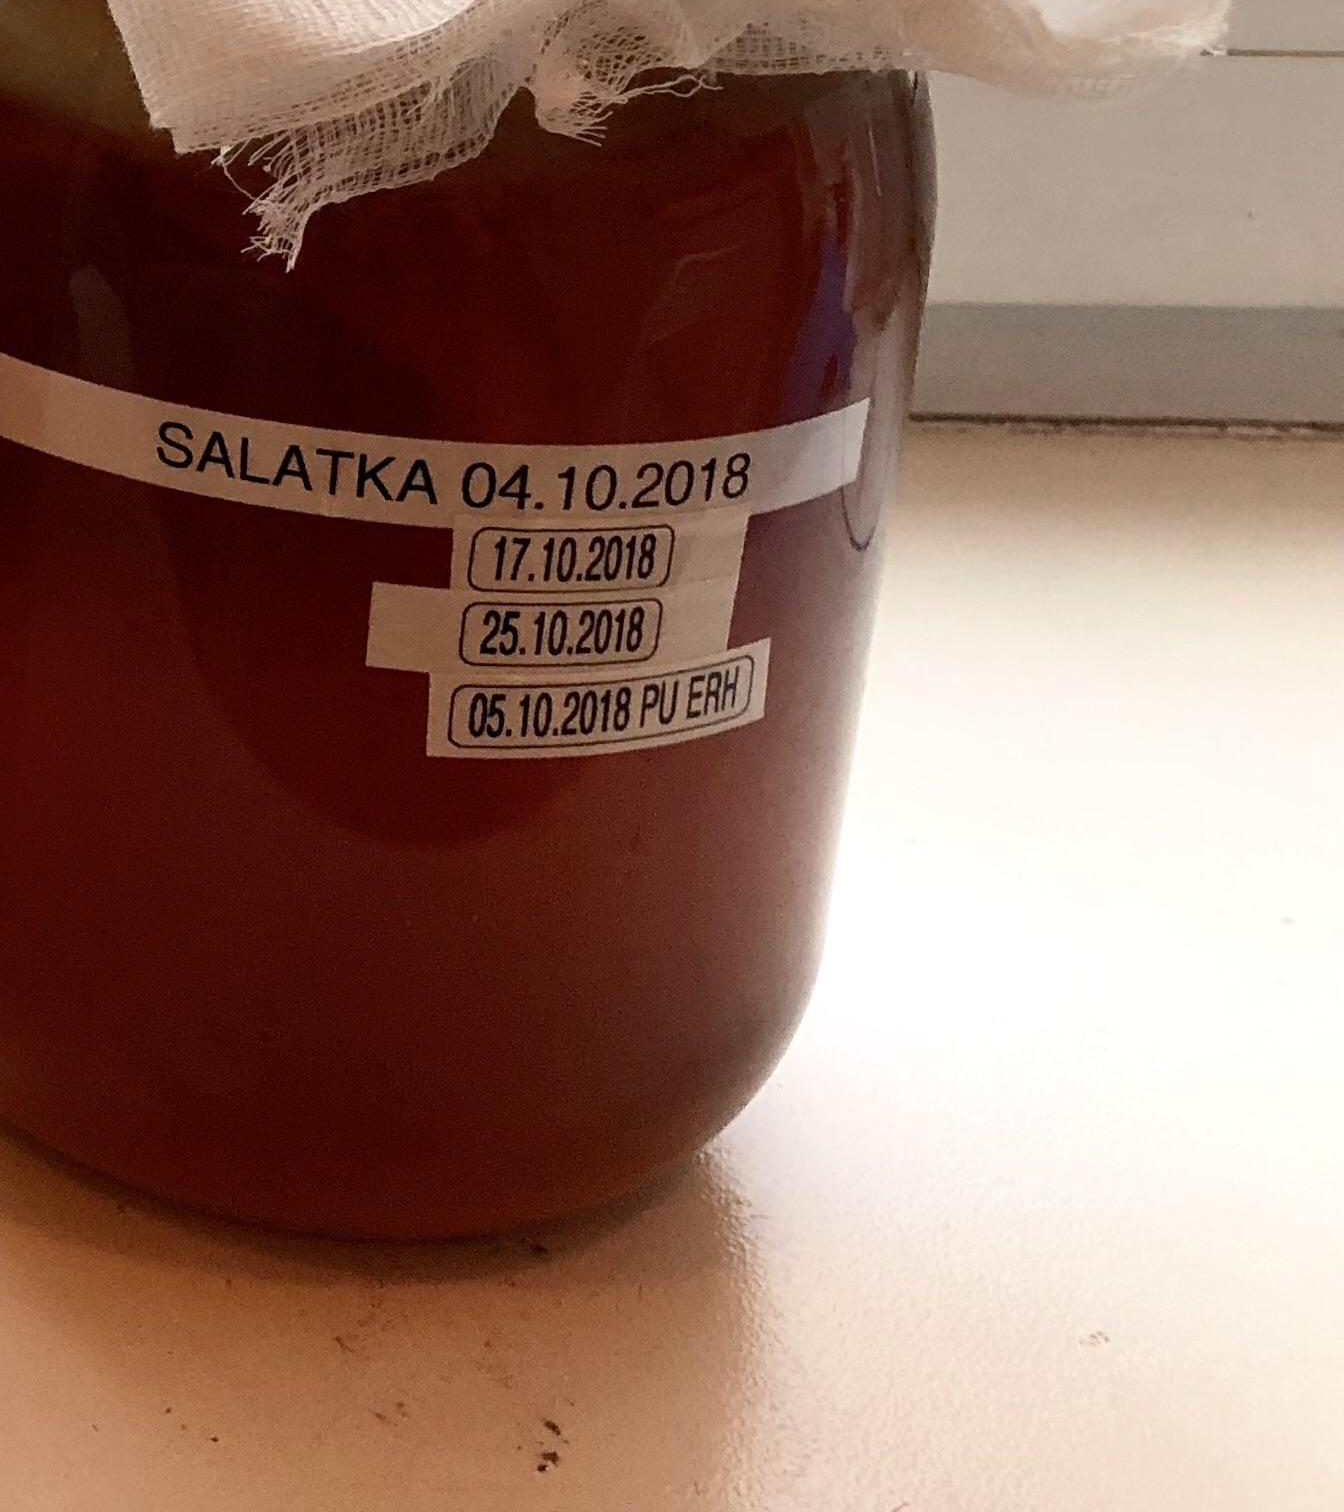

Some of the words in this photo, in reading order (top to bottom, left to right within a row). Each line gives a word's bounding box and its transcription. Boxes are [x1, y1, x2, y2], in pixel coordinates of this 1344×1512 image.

[156, 420, 438, 505] SALATKA
[461, 452, 752, 512] 04.10.2018
[492, 532, 658, 583] 17.10.2018
[478, 606, 645, 656] 25.10.2018
[468, 687, 631, 739] 05.10.2018
[639, 686, 679, 729] PU
[686, 666, 739, 721] ERH
